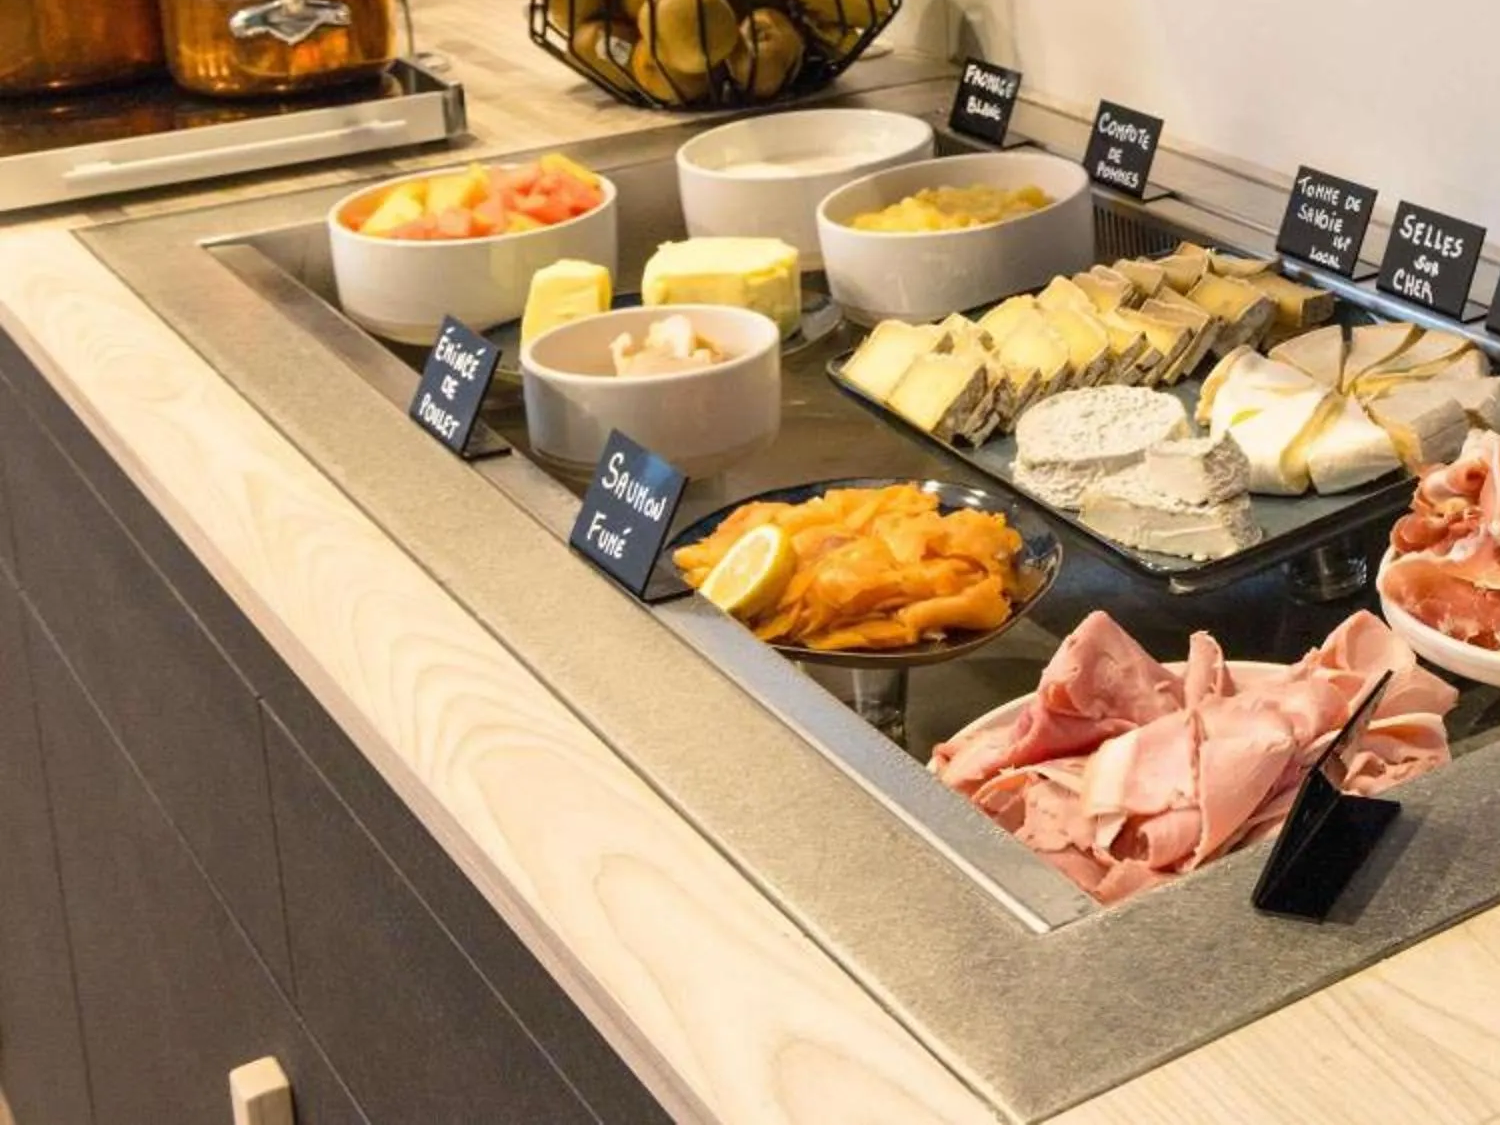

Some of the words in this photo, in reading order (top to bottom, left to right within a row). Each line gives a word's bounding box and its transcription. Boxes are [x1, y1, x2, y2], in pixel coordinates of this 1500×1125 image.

[1098, 112, 1151, 151] COMPOTE
[1107, 146, 1123, 165] DE
[1096, 160, 1140, 189] POMMES
[1298, 176, 1341, 206] TOMME
[1344, 195, 1362, 213] DE
[1399, 214, 1465, 258] SELLES
[1308, 244, 1341, 270] LOCAL
[1392, 267, 1433, 305] CHER
[441, 375, 459, 401] DE
[419, 392, 460, 440] POULET
